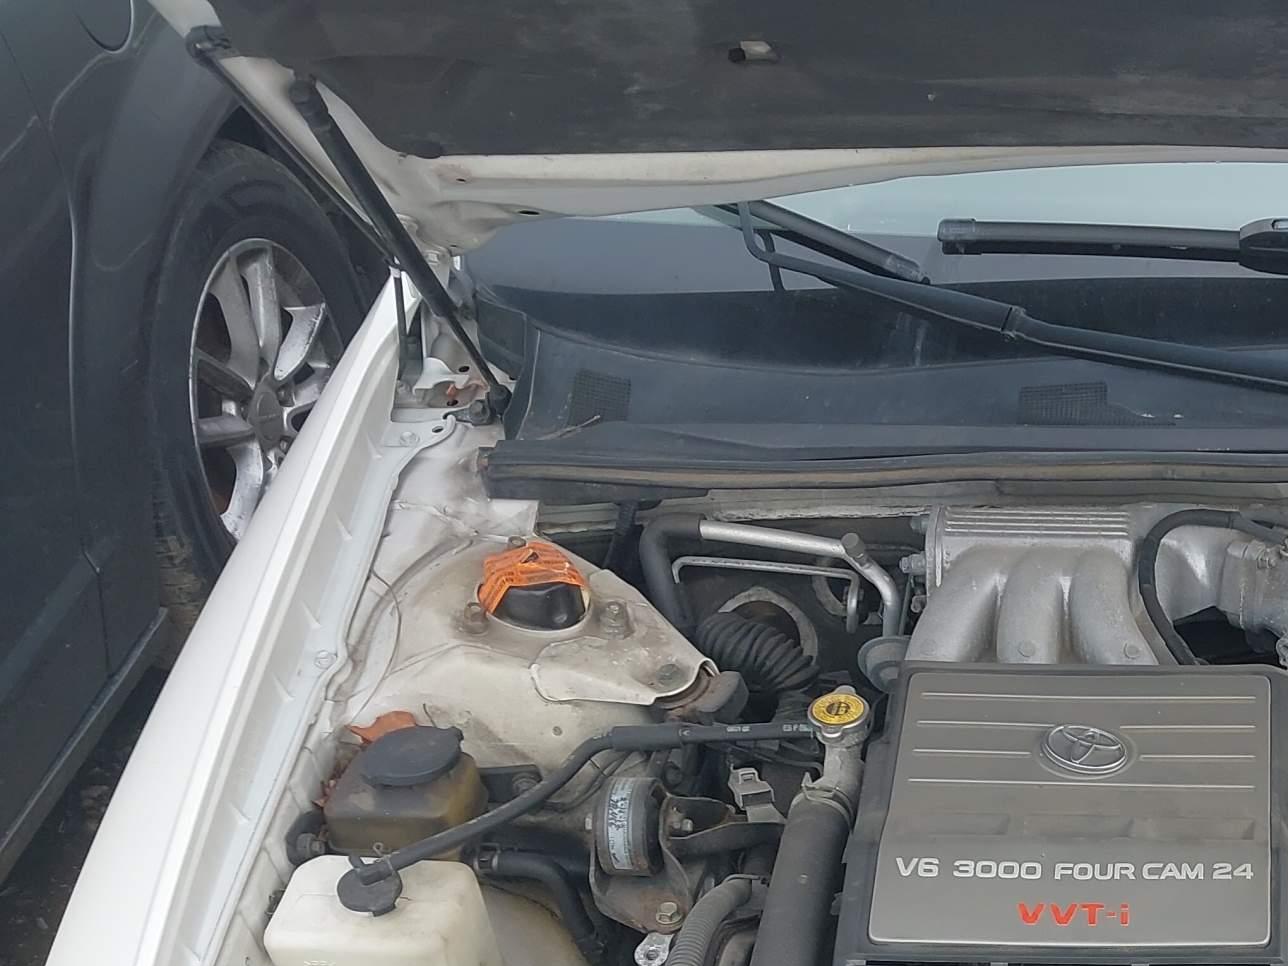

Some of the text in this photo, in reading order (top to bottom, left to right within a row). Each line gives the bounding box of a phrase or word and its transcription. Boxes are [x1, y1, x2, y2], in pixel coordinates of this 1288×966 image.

[895, 857, 1255, 881] V6 3000 FOUR CAM 24
[1017, 902, 1130, 927] VVT-i
